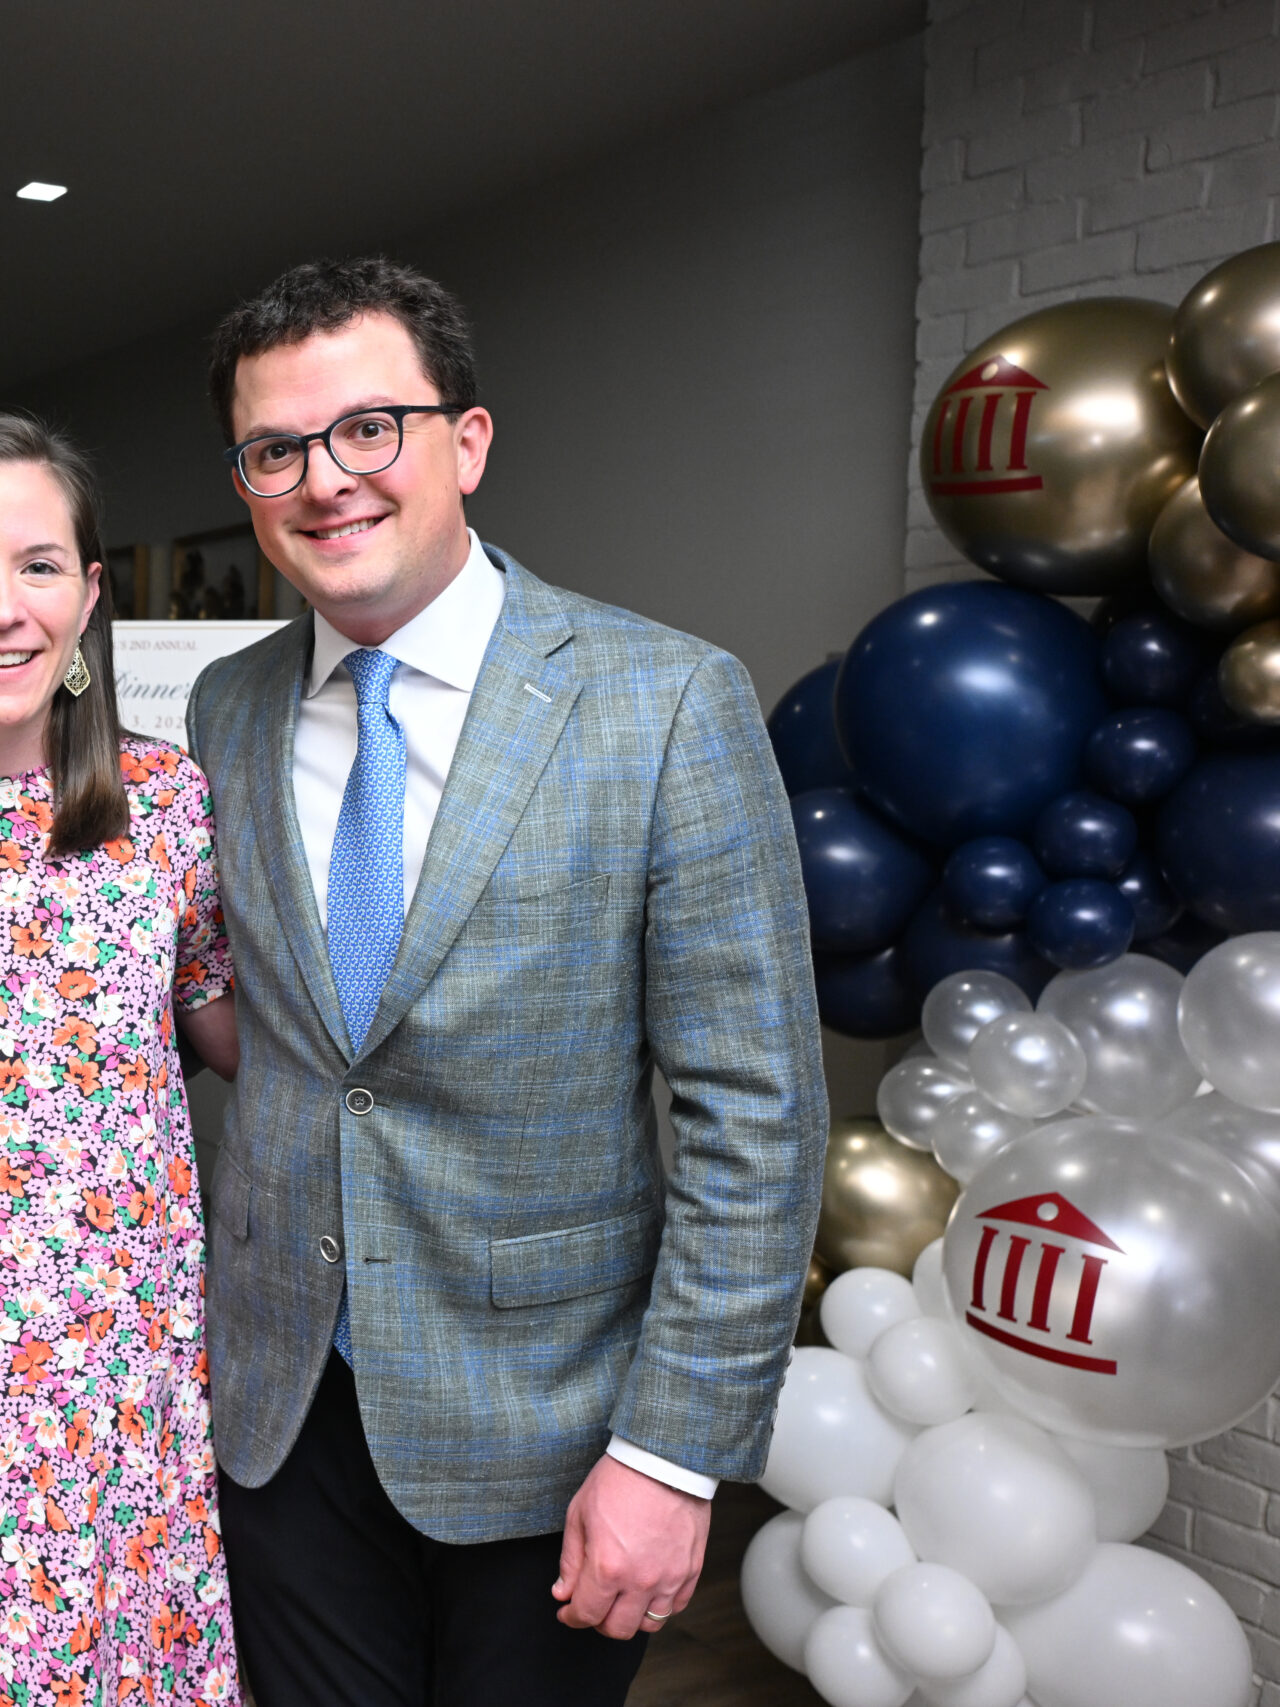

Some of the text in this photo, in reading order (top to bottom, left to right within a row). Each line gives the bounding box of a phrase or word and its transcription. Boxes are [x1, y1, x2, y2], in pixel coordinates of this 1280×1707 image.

[129, 640, 151, 651] 2ND
[153, 640, 197, 651] ANNUAL
[154, 715, 184, 729] 202
